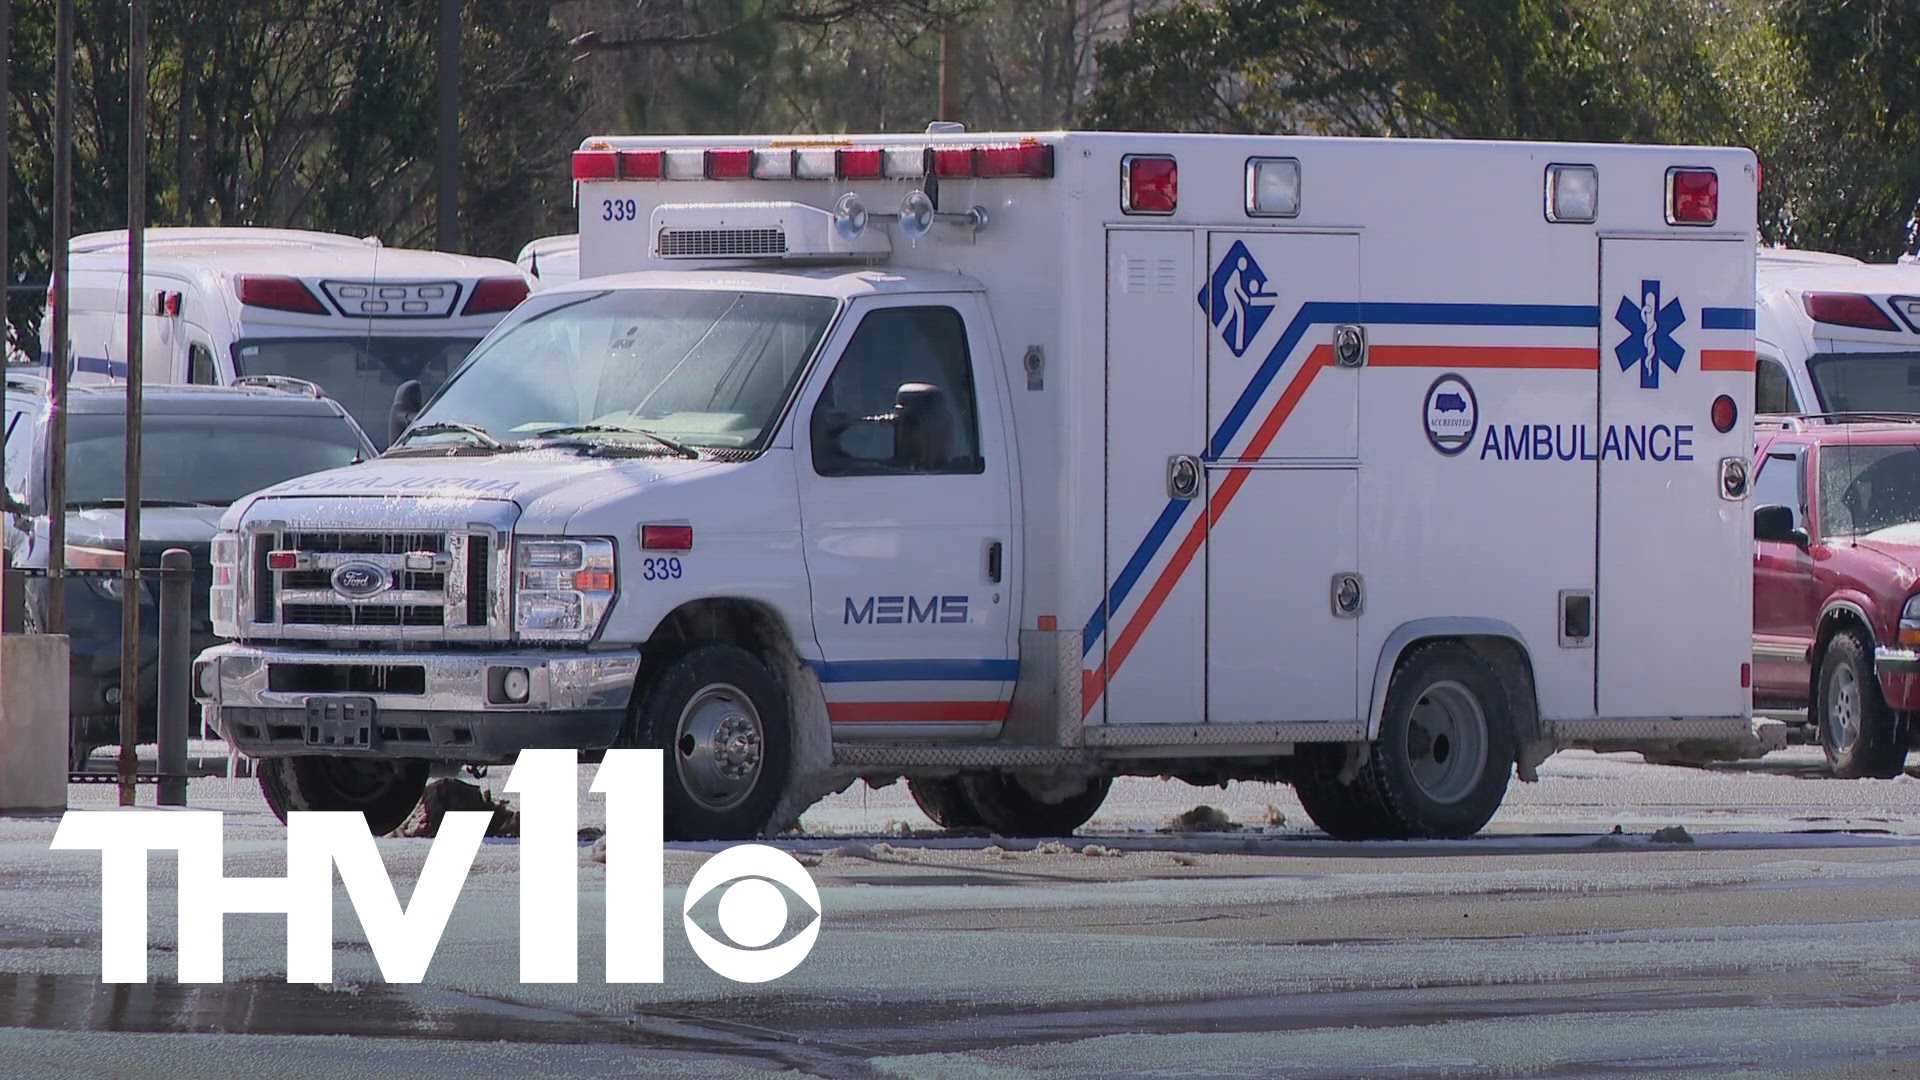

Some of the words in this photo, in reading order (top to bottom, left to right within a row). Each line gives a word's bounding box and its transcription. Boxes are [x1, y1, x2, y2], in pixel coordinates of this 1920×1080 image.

[602, 199, 637, 221] 339
[1431, 418, 1472, 427] ACCREDITED
[1480, 424, 1694, 461] AMBULANCE
[343, 570, 370, 587] Ford
[643, 556, 682, 581] 339
[843, 595, 969, 625] MEMS
